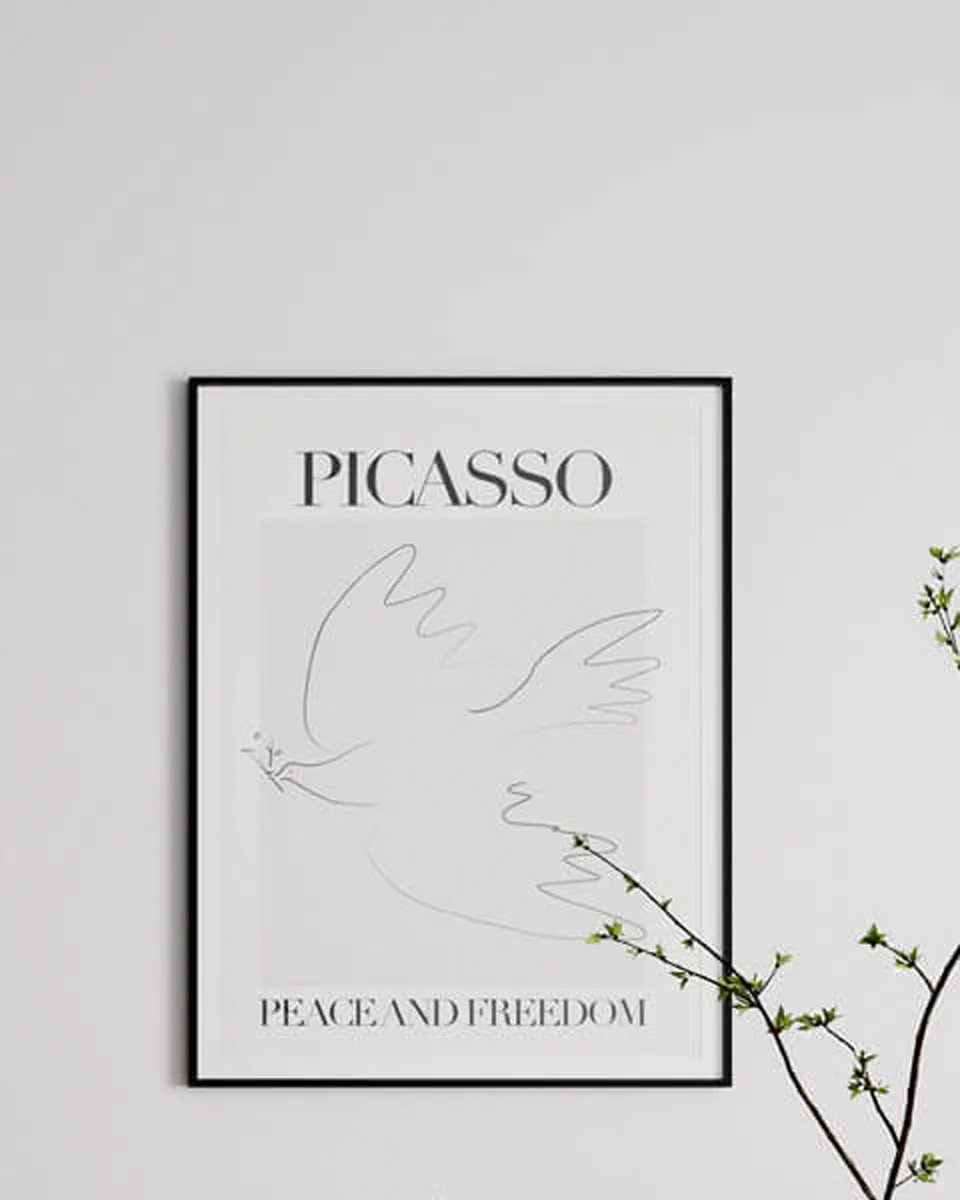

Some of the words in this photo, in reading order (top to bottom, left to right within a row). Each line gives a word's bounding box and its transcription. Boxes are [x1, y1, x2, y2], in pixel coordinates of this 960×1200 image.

[296, 450, 613, 508] PICASSO
[259, 998, 377, 1027] PEACE
[382, 998, 459, 1027] AND
[468, 998, 646, 1027] FREEDOM
